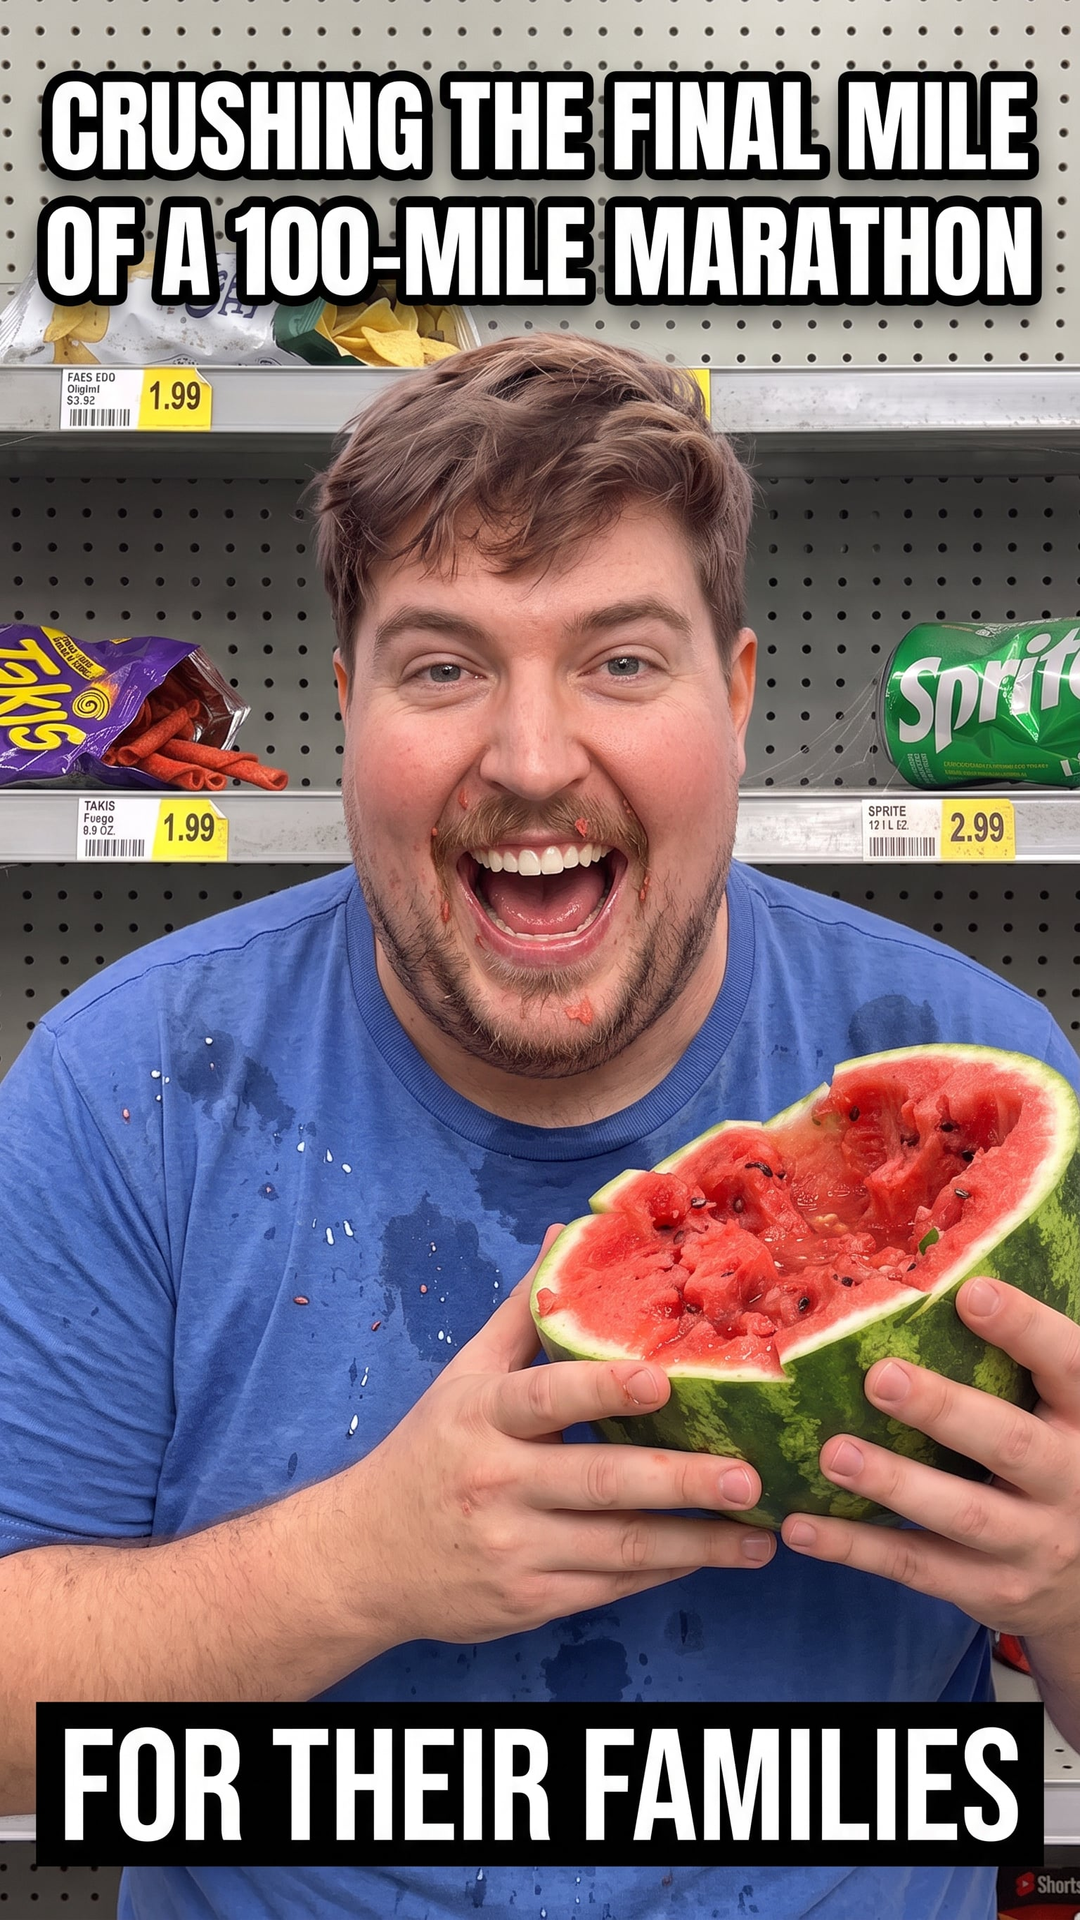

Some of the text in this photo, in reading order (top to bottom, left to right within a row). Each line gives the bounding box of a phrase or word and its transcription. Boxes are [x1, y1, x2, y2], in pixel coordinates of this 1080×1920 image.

[66, 395, 96, 406] $3.92
[149, 380, 201, 410] 1.99
[899, 627, 1080, 754] Sprit
[84, 800, 116, 812] TAKIS
[868, 805, 907, 817] SPRITE
[83, 812, 114, 826] Fuego
[868, 819, 880, 831] 12
[163, 812, 215, 842] 1.99
[950, 812, 1005, 843] 2.99
